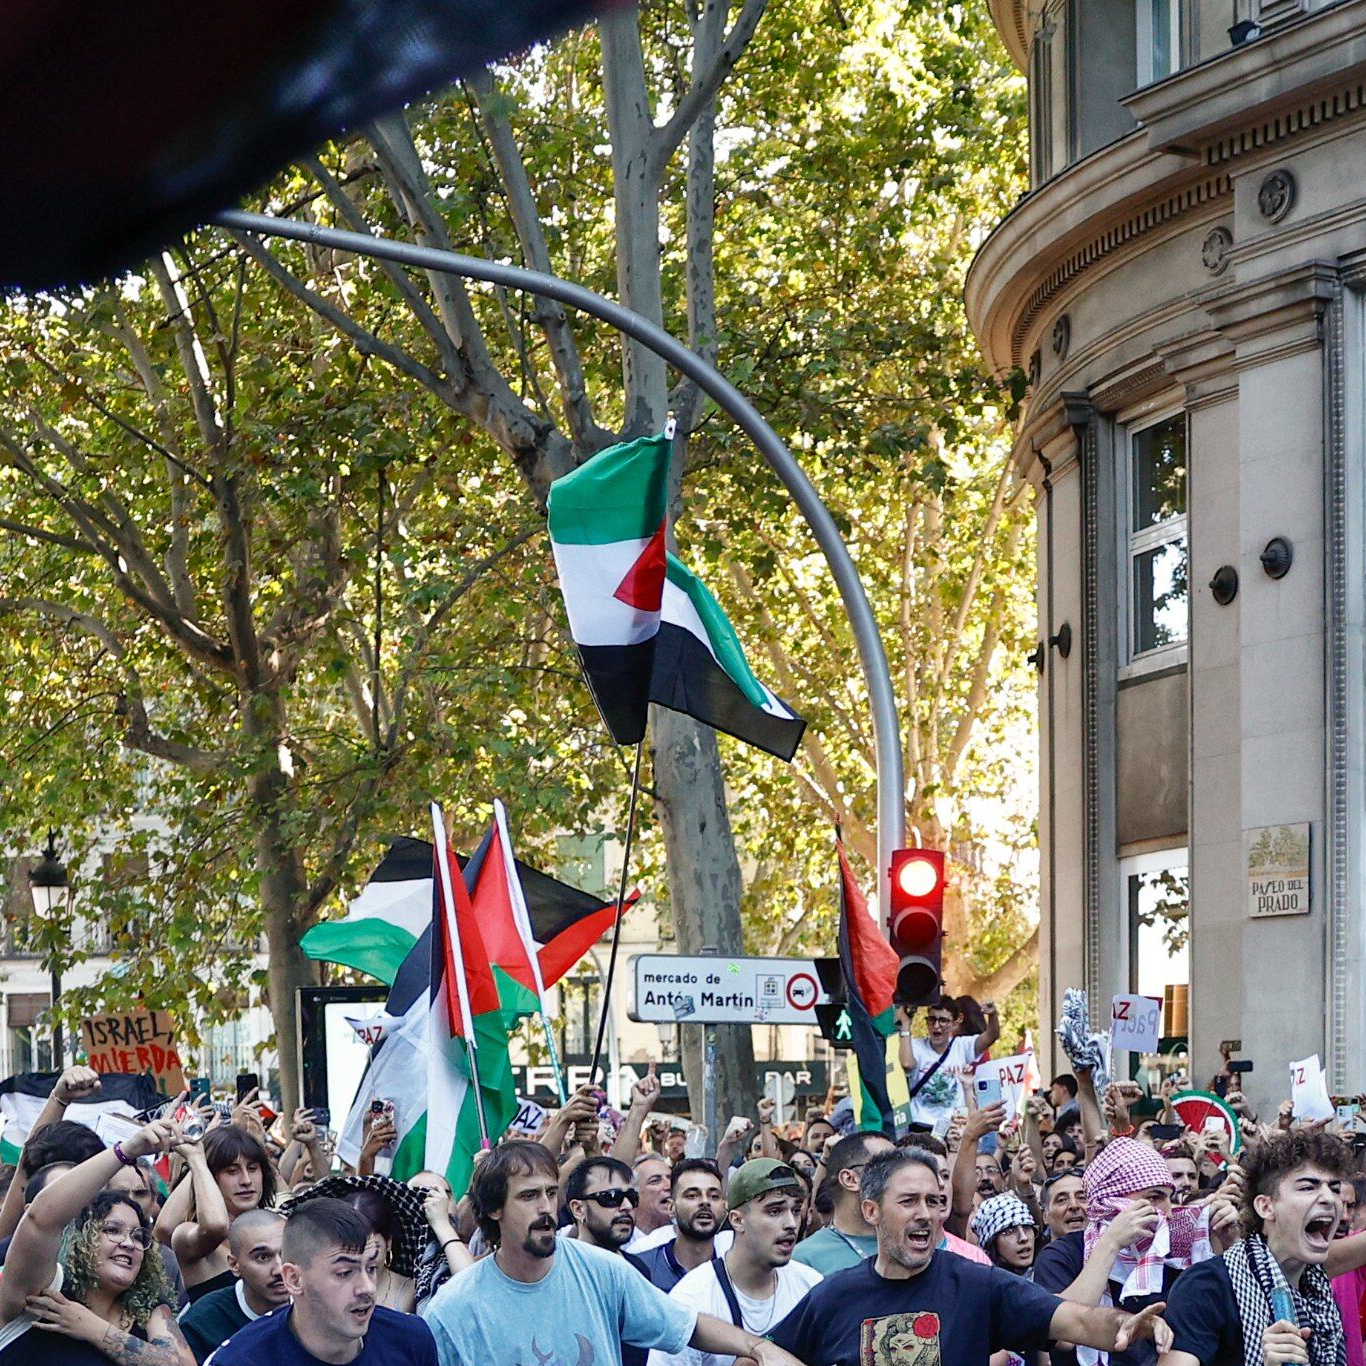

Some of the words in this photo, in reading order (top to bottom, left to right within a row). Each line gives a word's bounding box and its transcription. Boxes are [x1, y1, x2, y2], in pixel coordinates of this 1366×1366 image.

[1252, 880, 1285, 895] PASEO
[1288, 880, 1304, 890] DEL
[1258, 893, 1298, 912] PRADO
[644, 973, 698, 984] mercado
[705, 973, 721, 984] de
[701, 992, 754, 1008] Martín
[83, 1012, 174, 1046] ISRAEL,
[357, 1025, 383, 1045] PAZ
[90, 1044, 182, 1074] MIERDA
[999, 1064, 1024, 1088] PAZ
[512, 1104, 543, 1134] AZ
